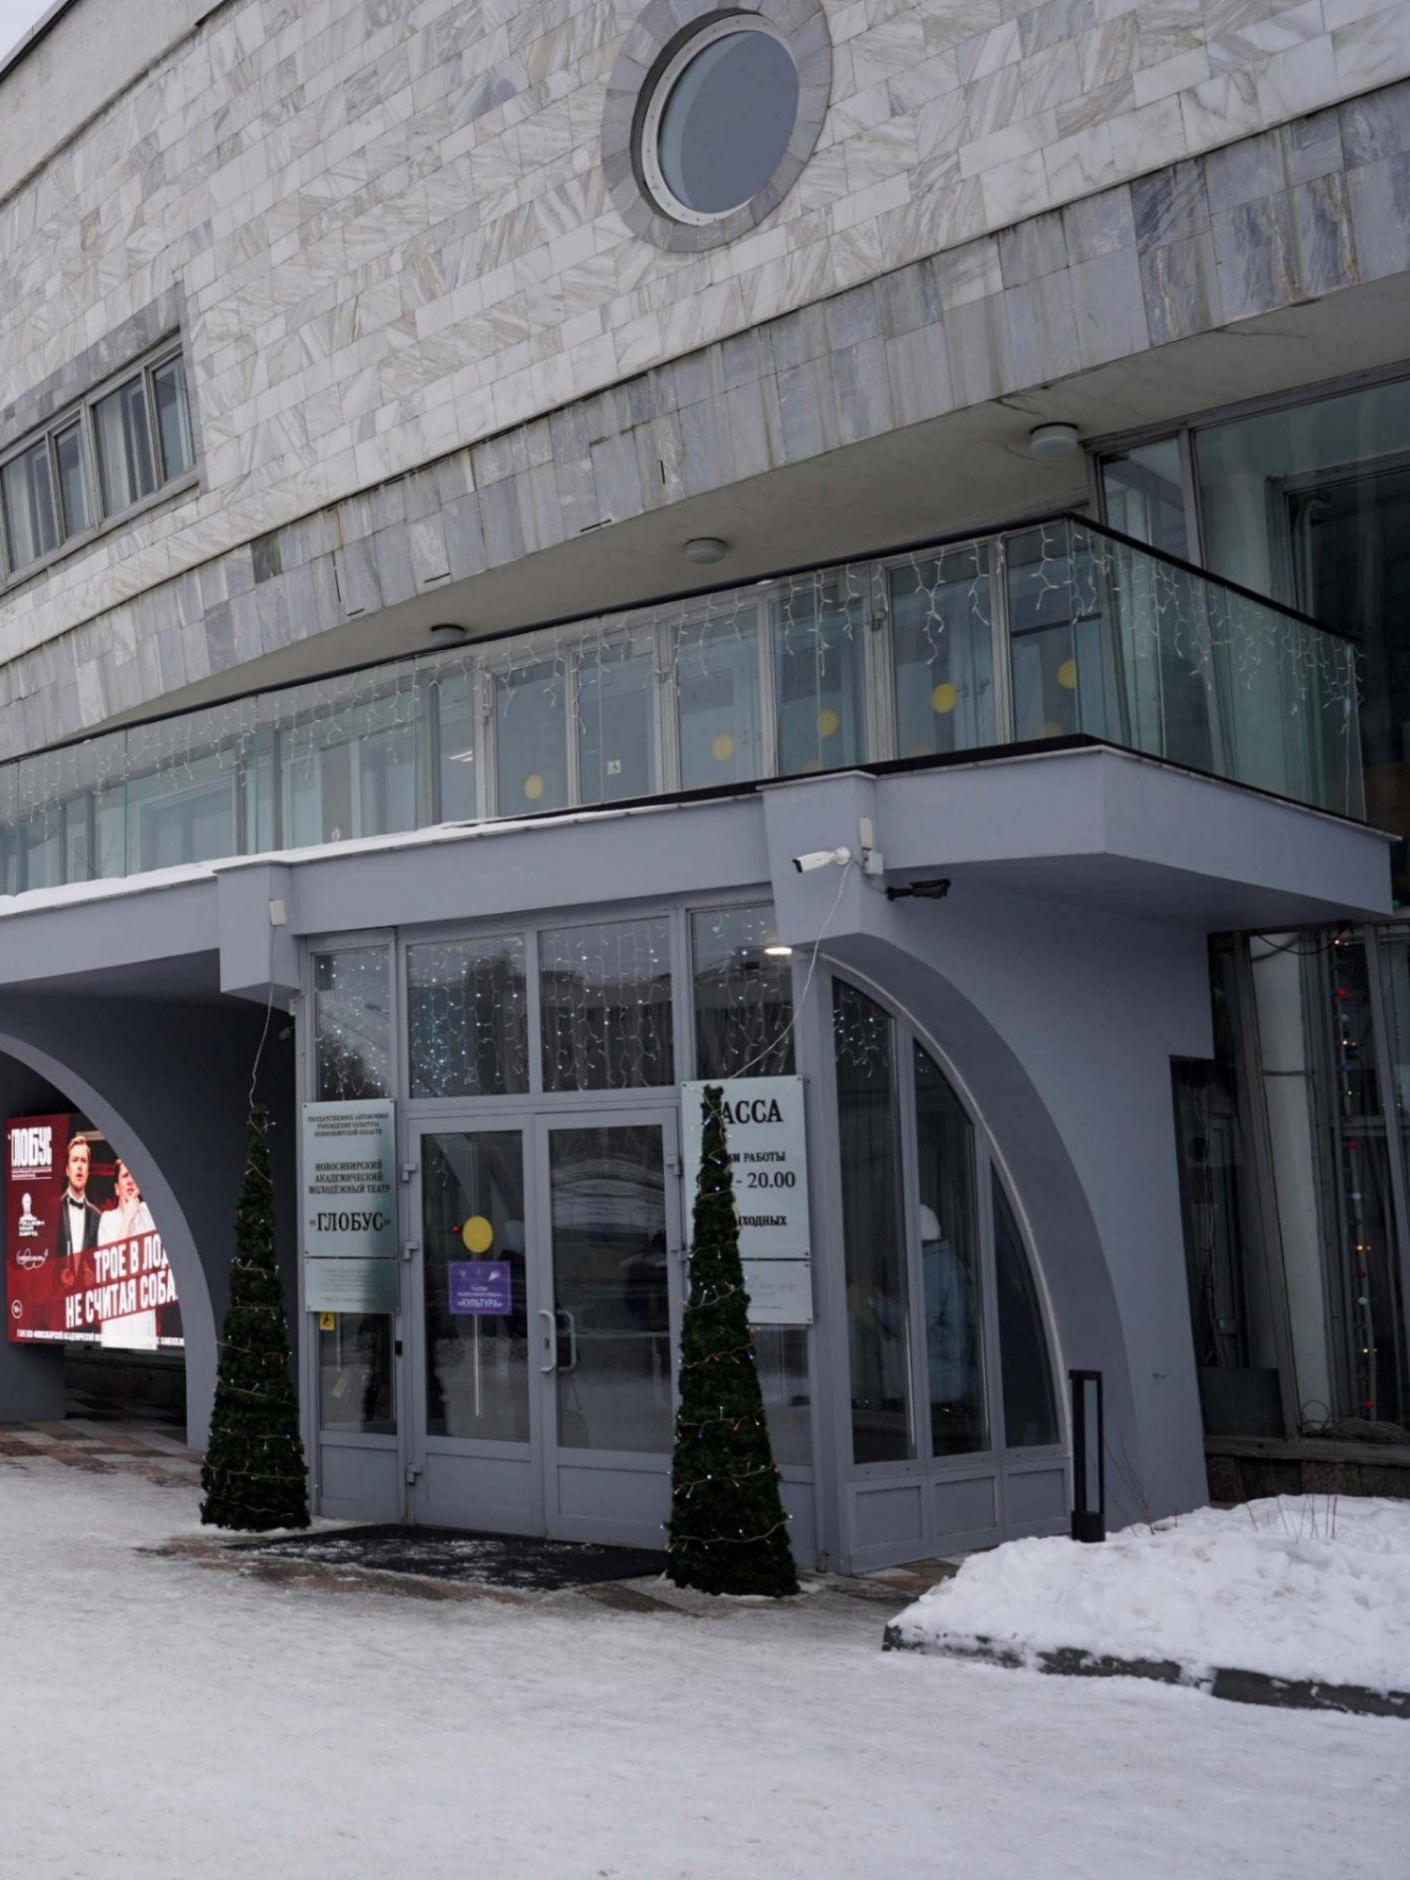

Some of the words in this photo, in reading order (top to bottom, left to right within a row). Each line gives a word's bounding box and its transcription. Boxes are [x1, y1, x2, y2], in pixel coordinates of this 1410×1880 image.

[744, 1151, 786, 1163] РАБОТЫ
[315, 1159, 382, 1171] НОВОСИБИРСКИЙ
[315, 1171, 383, 1183] АКАДЕМИЧЕСКИЙ
[747, 1171, 796, 1189] 20.00
[367, 1184, 391, 1193] ТЕАТР
[309, 1211, 391, 1232] «ГЛОБУС»
[93, 1243, 127, 1283] ТРОЕ
[130, 1241, 139, 1273] В
[65, 1294, 83, 1329] НЕ
[85, 1278, 136, 1323] СЧИТАЯ
[140, 1268, 178, 1309] СОБА
